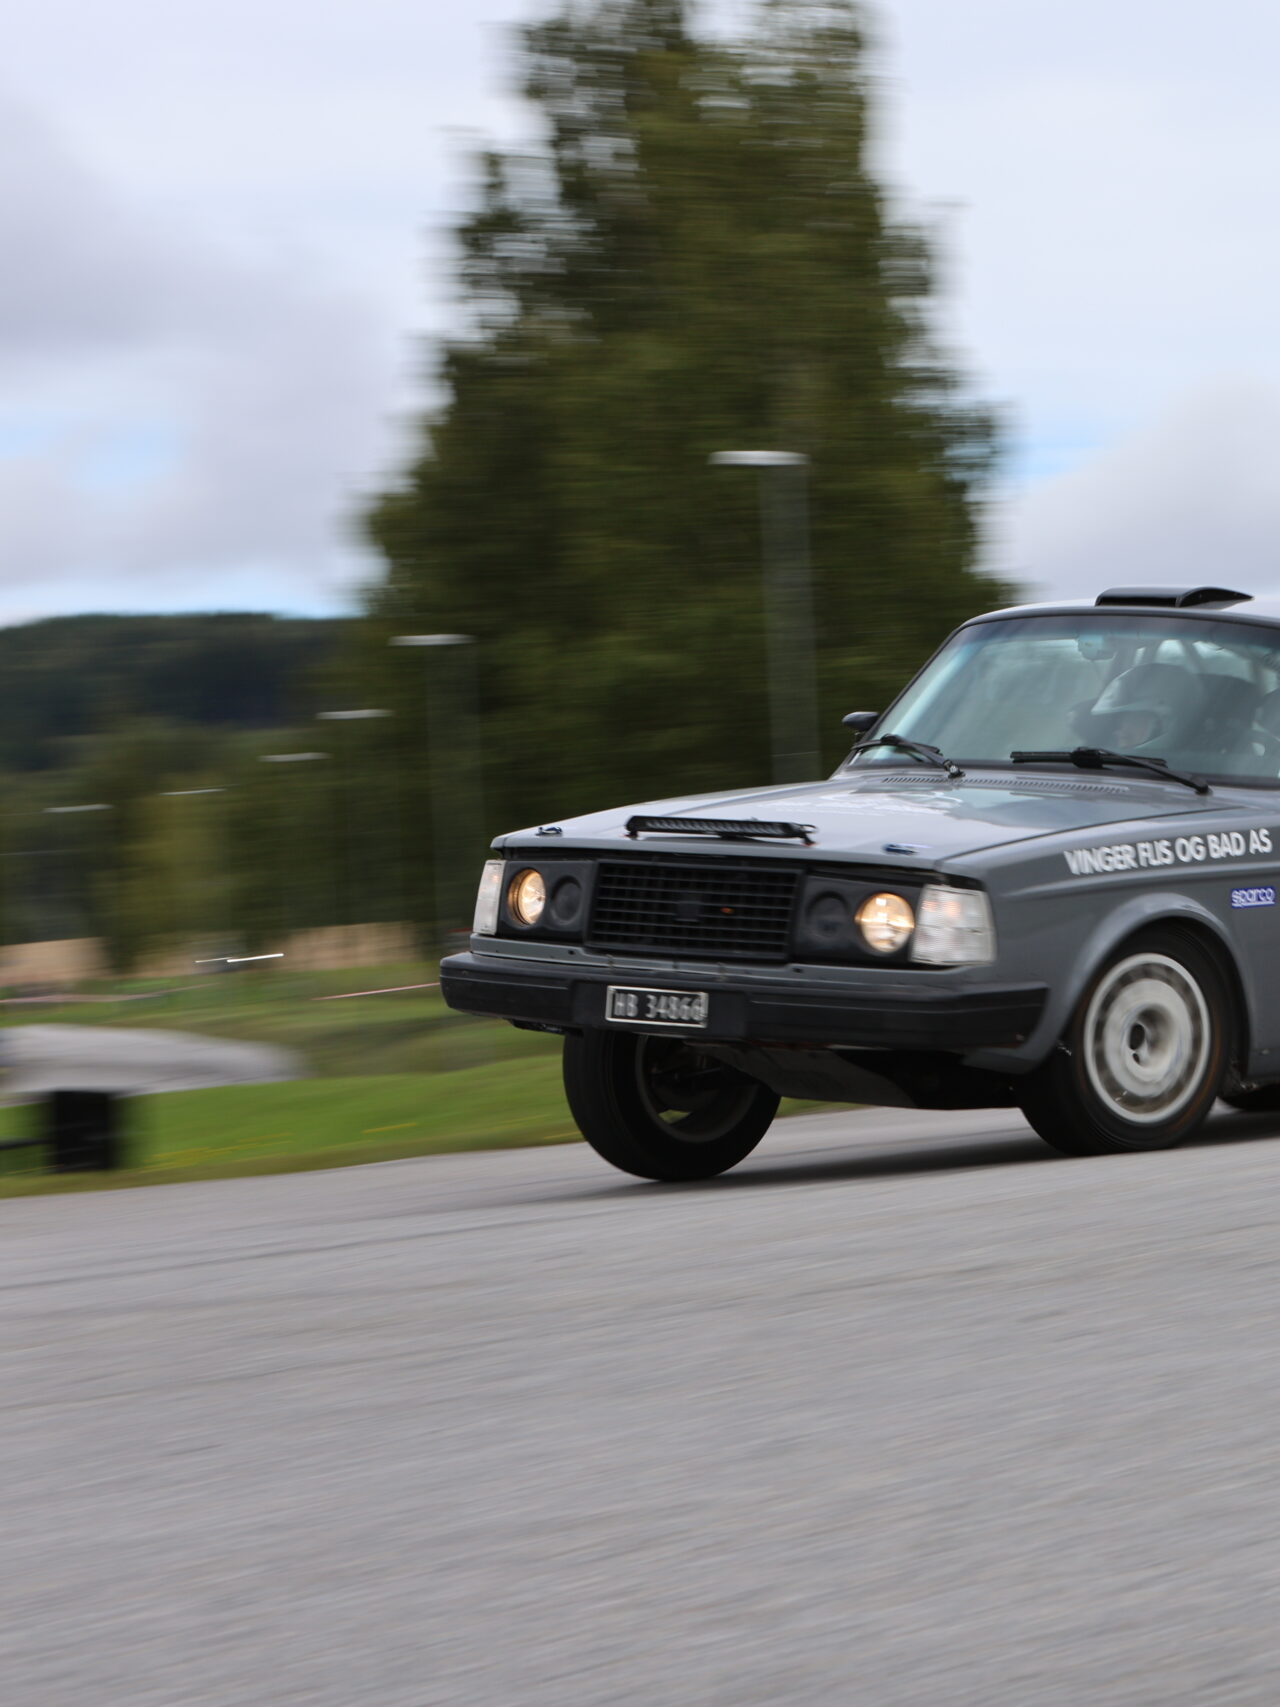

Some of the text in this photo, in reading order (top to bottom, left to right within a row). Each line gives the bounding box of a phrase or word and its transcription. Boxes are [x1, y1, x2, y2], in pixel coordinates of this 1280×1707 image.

[1064, 828, 1273, 875] VINGER FLIS OG BAD AS
[1231, 887, 1275, 907] sparco
